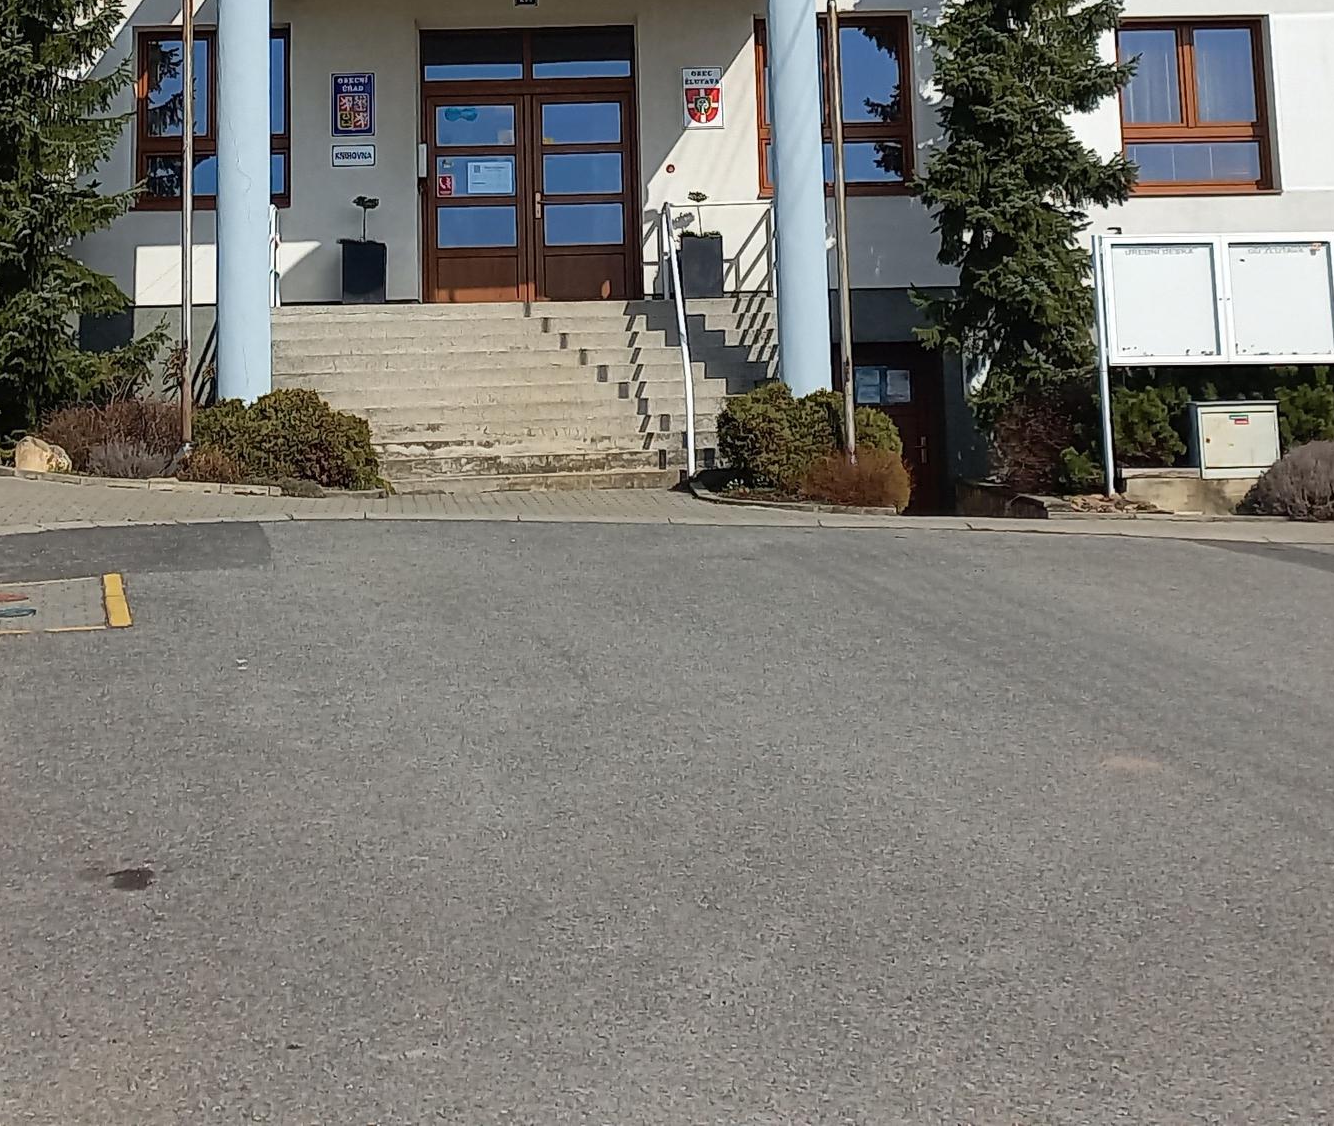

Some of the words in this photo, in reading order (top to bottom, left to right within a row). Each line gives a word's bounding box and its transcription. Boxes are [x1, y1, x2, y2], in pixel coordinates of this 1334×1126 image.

[337, 75, 368, 84] OBECNÍ
[342, 84, 364, 92] ÚŘAD
[334, 151, 373, 161] KNIHOVNA
